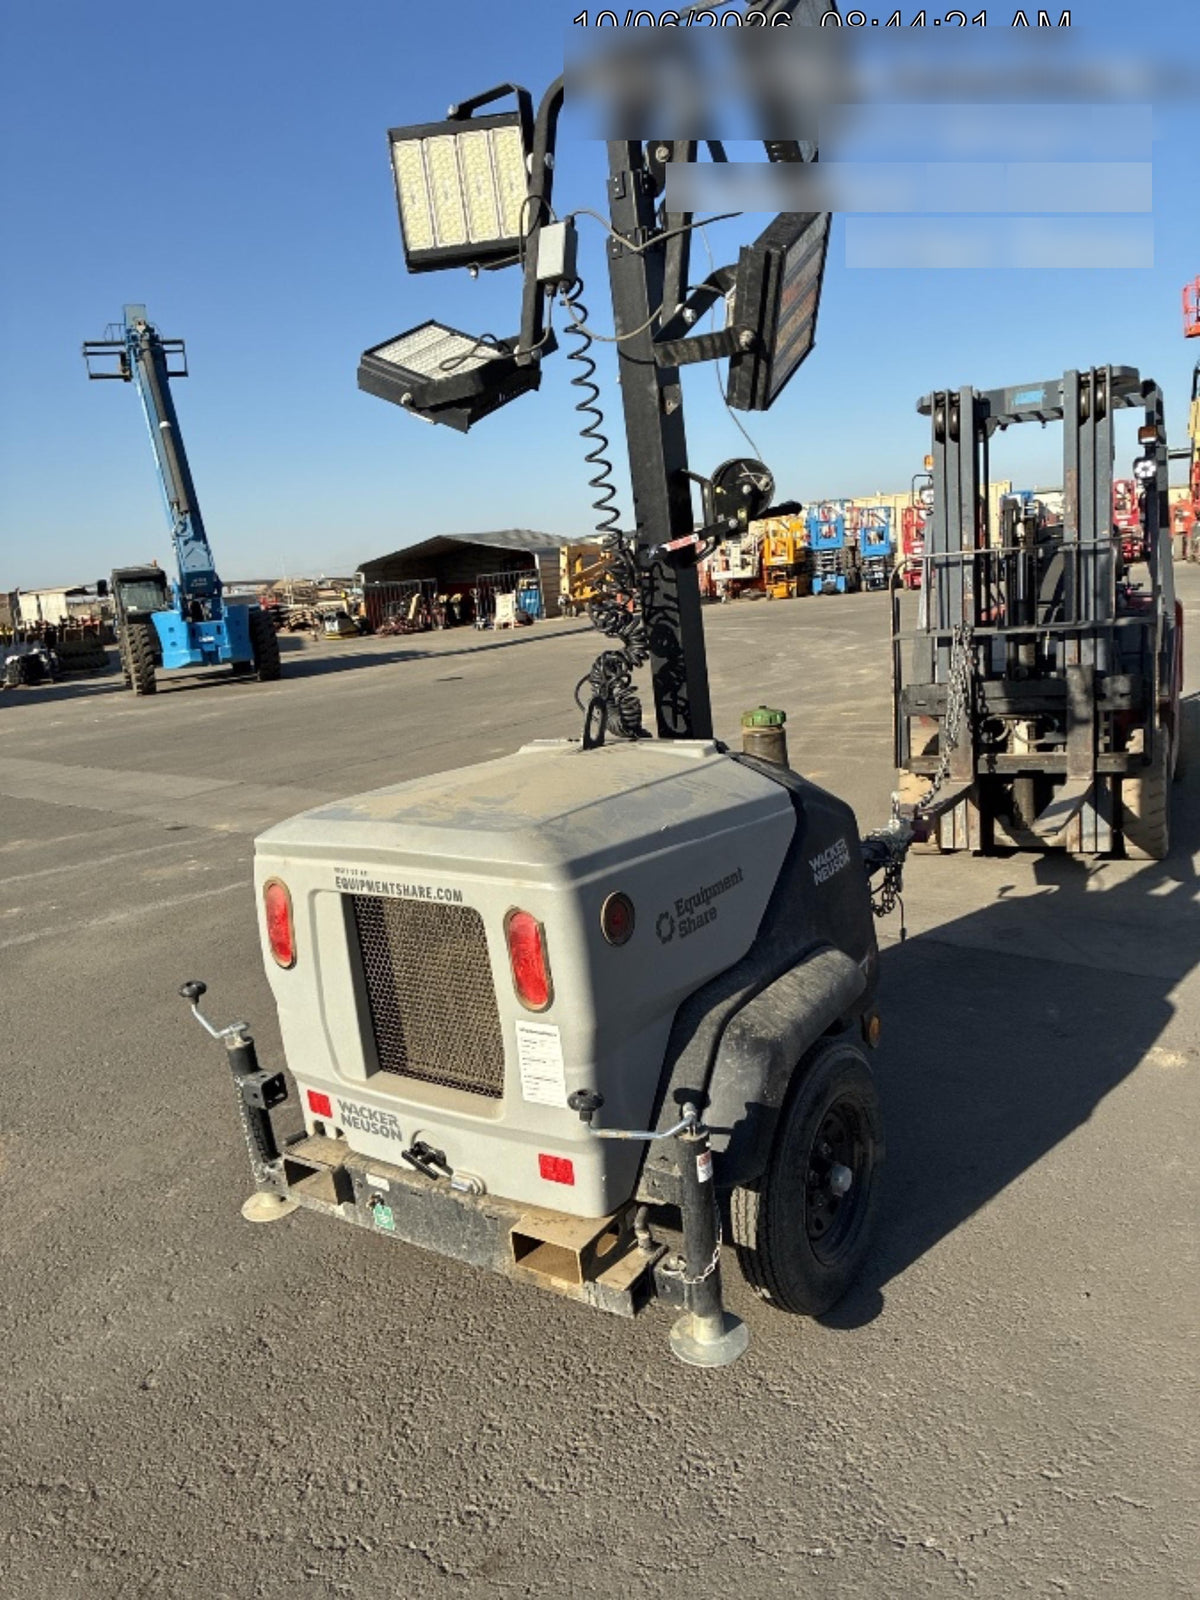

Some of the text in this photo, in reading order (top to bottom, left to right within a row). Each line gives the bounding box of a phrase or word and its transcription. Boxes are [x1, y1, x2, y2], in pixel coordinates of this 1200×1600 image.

[335, 876, 463, 903] EQUIPMENTSHARE.COM
[673, 866, 744, 918] Equipment
[678, 906, 718, 938] Share
[337, 1098, 401, 1130] WACKER
[340, 1112, 403, 1142] NEUSON
